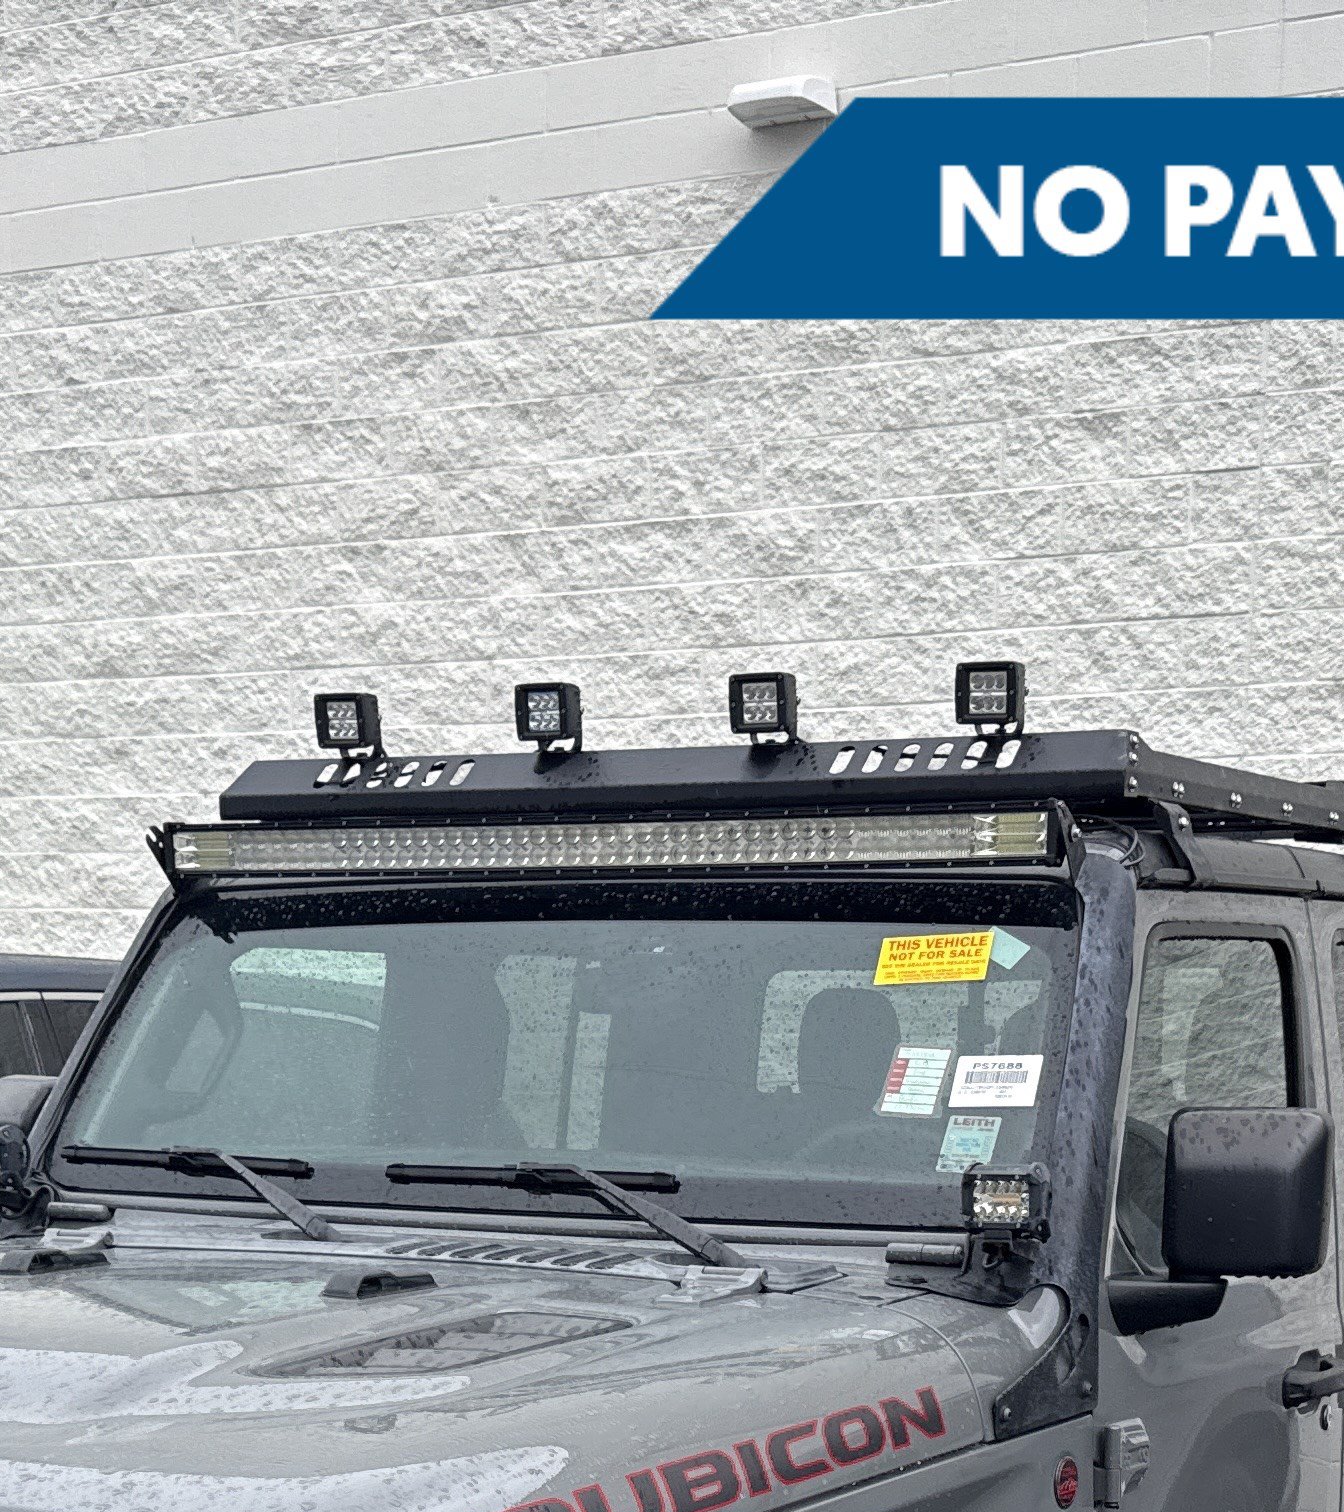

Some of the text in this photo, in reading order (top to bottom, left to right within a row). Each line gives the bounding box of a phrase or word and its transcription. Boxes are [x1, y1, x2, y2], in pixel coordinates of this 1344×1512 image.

[889, 935, 989, 951] THIS VEHICLE
[889, 948, 983, 961] NOT FOR SALE
[953, 1117, 996, 1127] LEITH
